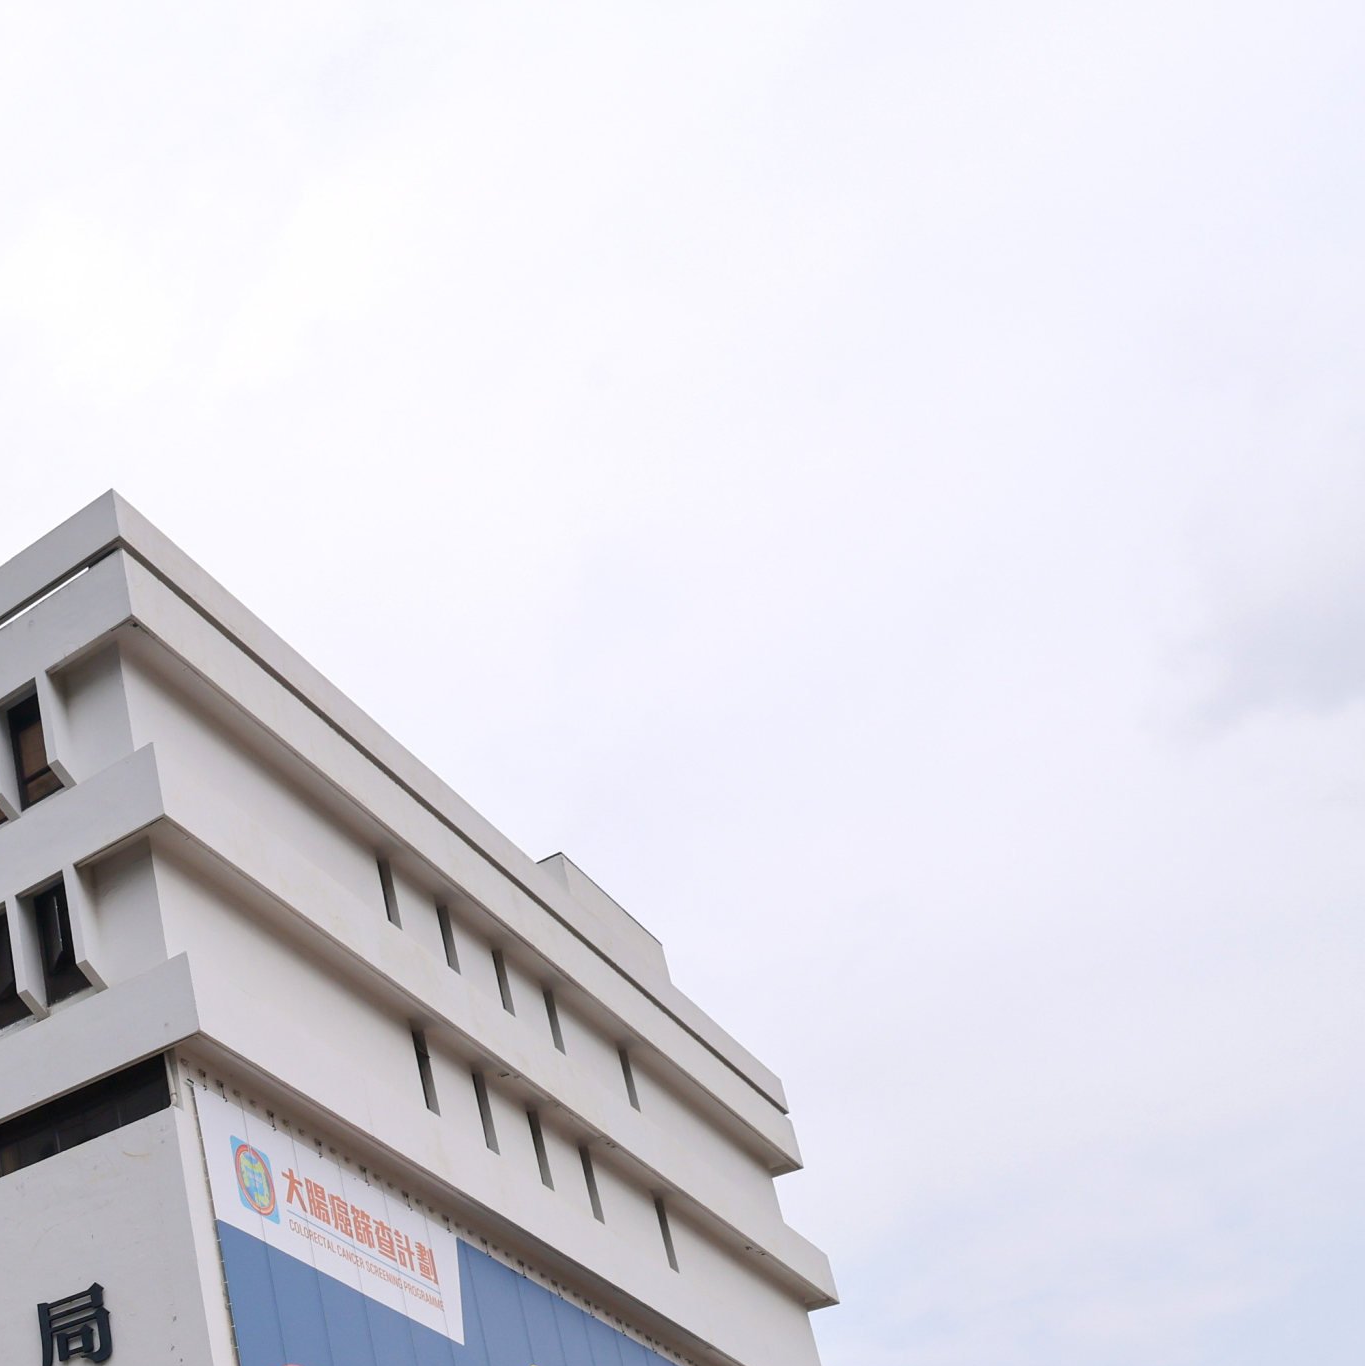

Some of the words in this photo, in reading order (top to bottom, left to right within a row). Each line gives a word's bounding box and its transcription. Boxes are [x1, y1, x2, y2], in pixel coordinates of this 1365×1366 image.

[281, 1168, 439, 1285] 大腸癌篩查計劃
[289, 1219, 337, 1253] COLORECTAL
[337, 1245, 366, 1268] CANCER
[365, 1255, 403, 1290] SCREENING
[403, 1280, 445, 1312] PROGRAMME
